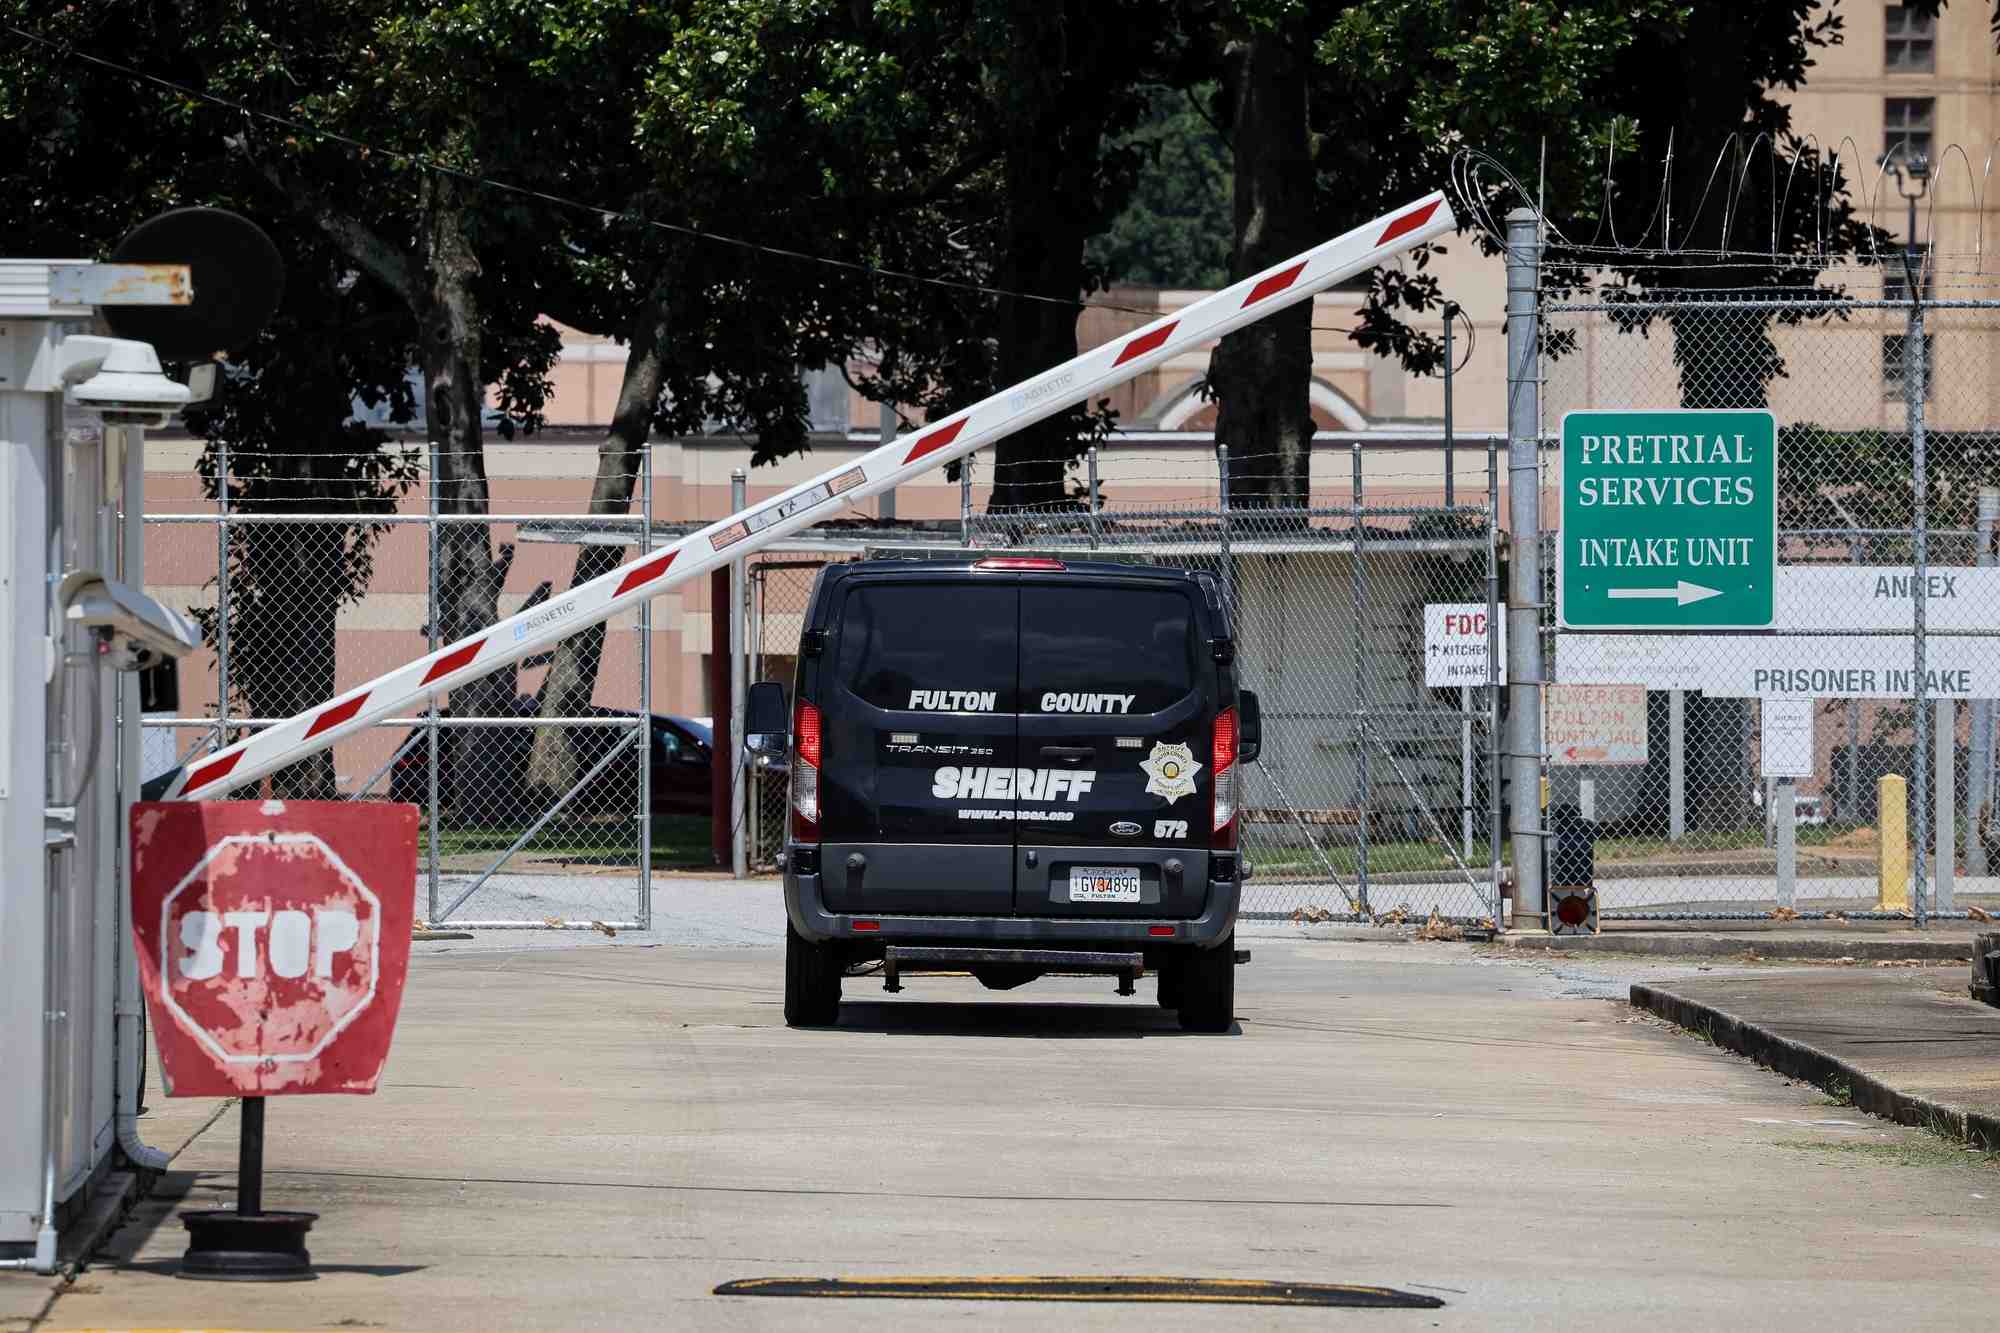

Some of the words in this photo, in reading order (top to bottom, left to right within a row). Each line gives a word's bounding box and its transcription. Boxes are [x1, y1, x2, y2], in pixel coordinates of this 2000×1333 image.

[1580, 434, 1753, 465] PRETRIAL
[1579, 476, 1754, 506] SERVICES
[1579, 538, 1679, 567] INTAKE
[1686, 538, 1754, 567] UNIT
[1445, 613, 1487, 636] FDC
[1447, 665, 1487, 676] INTAKE
[1754, 668, 1876, 692] PRISONER
[908, 690, 996, 711] FULTON
[1041, 692, 1136, 713] COUNTY
[886, 744, 969, 754] TRANSIT
[932, 767, 1096, 801] SHERIFF
[1154, 820, 1188, 838] 572
[1081, 877, 1137, 892] GV3489G
[180, 911, 358, 980] STOP
